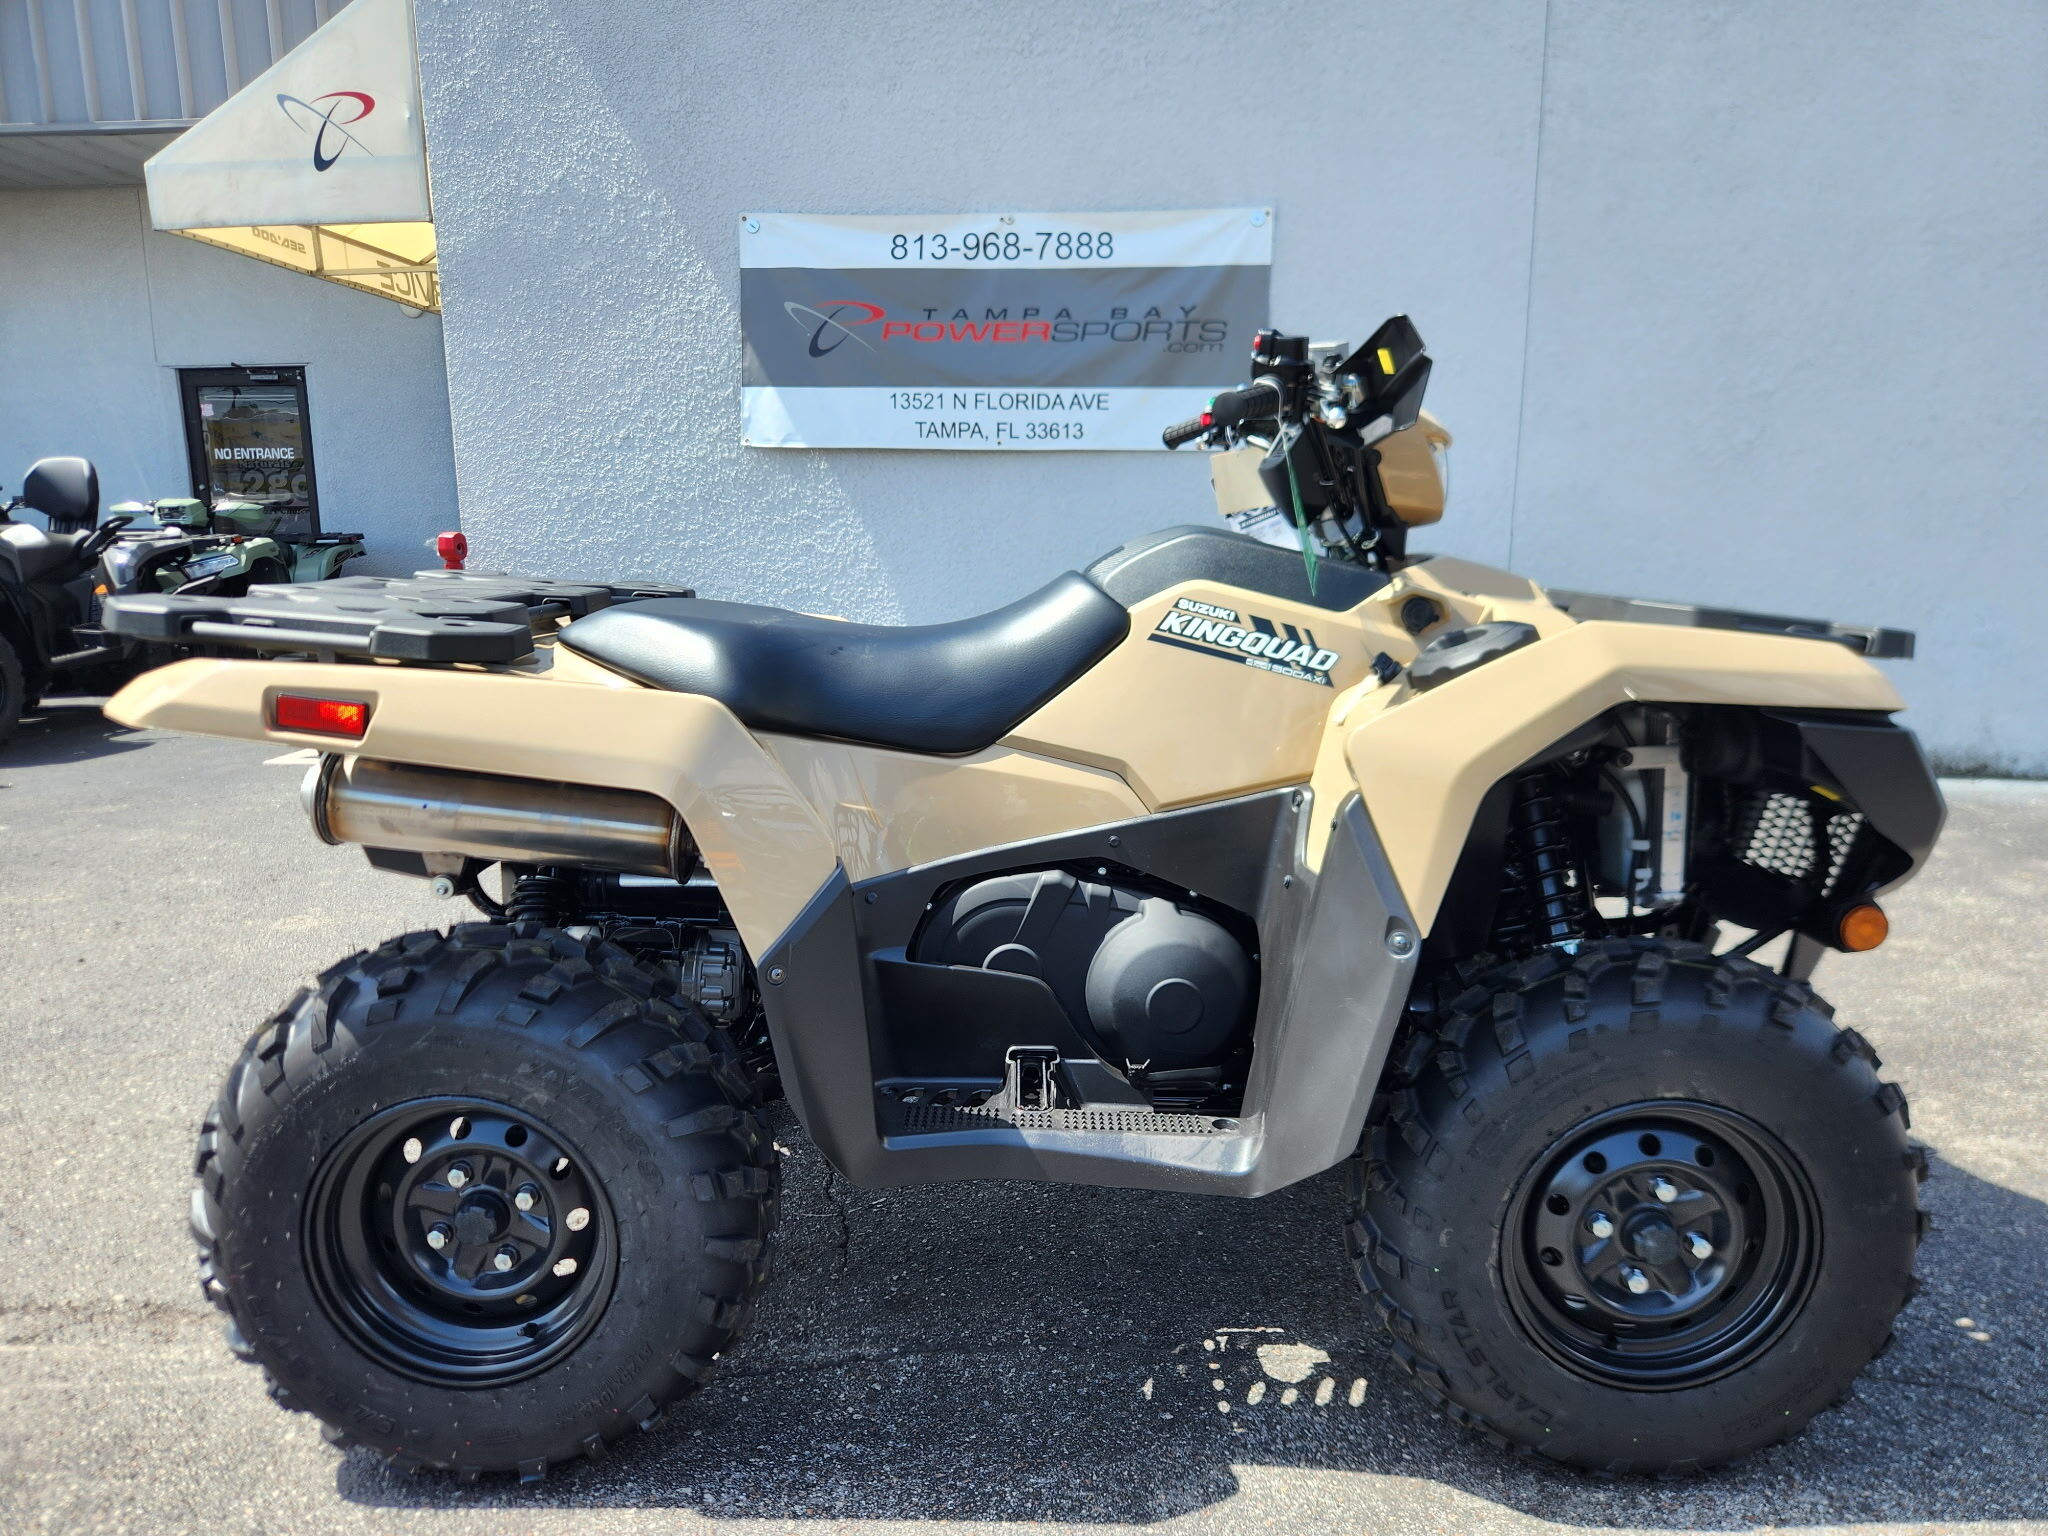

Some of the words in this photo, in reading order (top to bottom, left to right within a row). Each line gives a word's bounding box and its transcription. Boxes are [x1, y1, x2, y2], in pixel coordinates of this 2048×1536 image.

[890, 231, 1114, 261] 813-968-7888
[922, 307, 1073, 321] TAMPA
[1110, 304, 1198, 320] BAY
[881, 318, 1228, 344] POWERSPORTS
[1163, 341, 1225, 354] .com
[889, 393, 944, 411] 13521
[953, 393, 967, 411] N
[974, 392, 1065, 411] FLORIDA
[1067, 392, 1110, 411] AVE
[914, 421, 989, 442] TAMPA,
[996, 421, 1022, 440] FL
[1026, 422, 1084, 440] 33613
[214, 447, 232, 460] NO
[234, 447, 295, 460] ENTRANCE
[1177, 597, 1236, 622] SUZUKI
[1159, 611, 1339, 672] KINGQUAD
